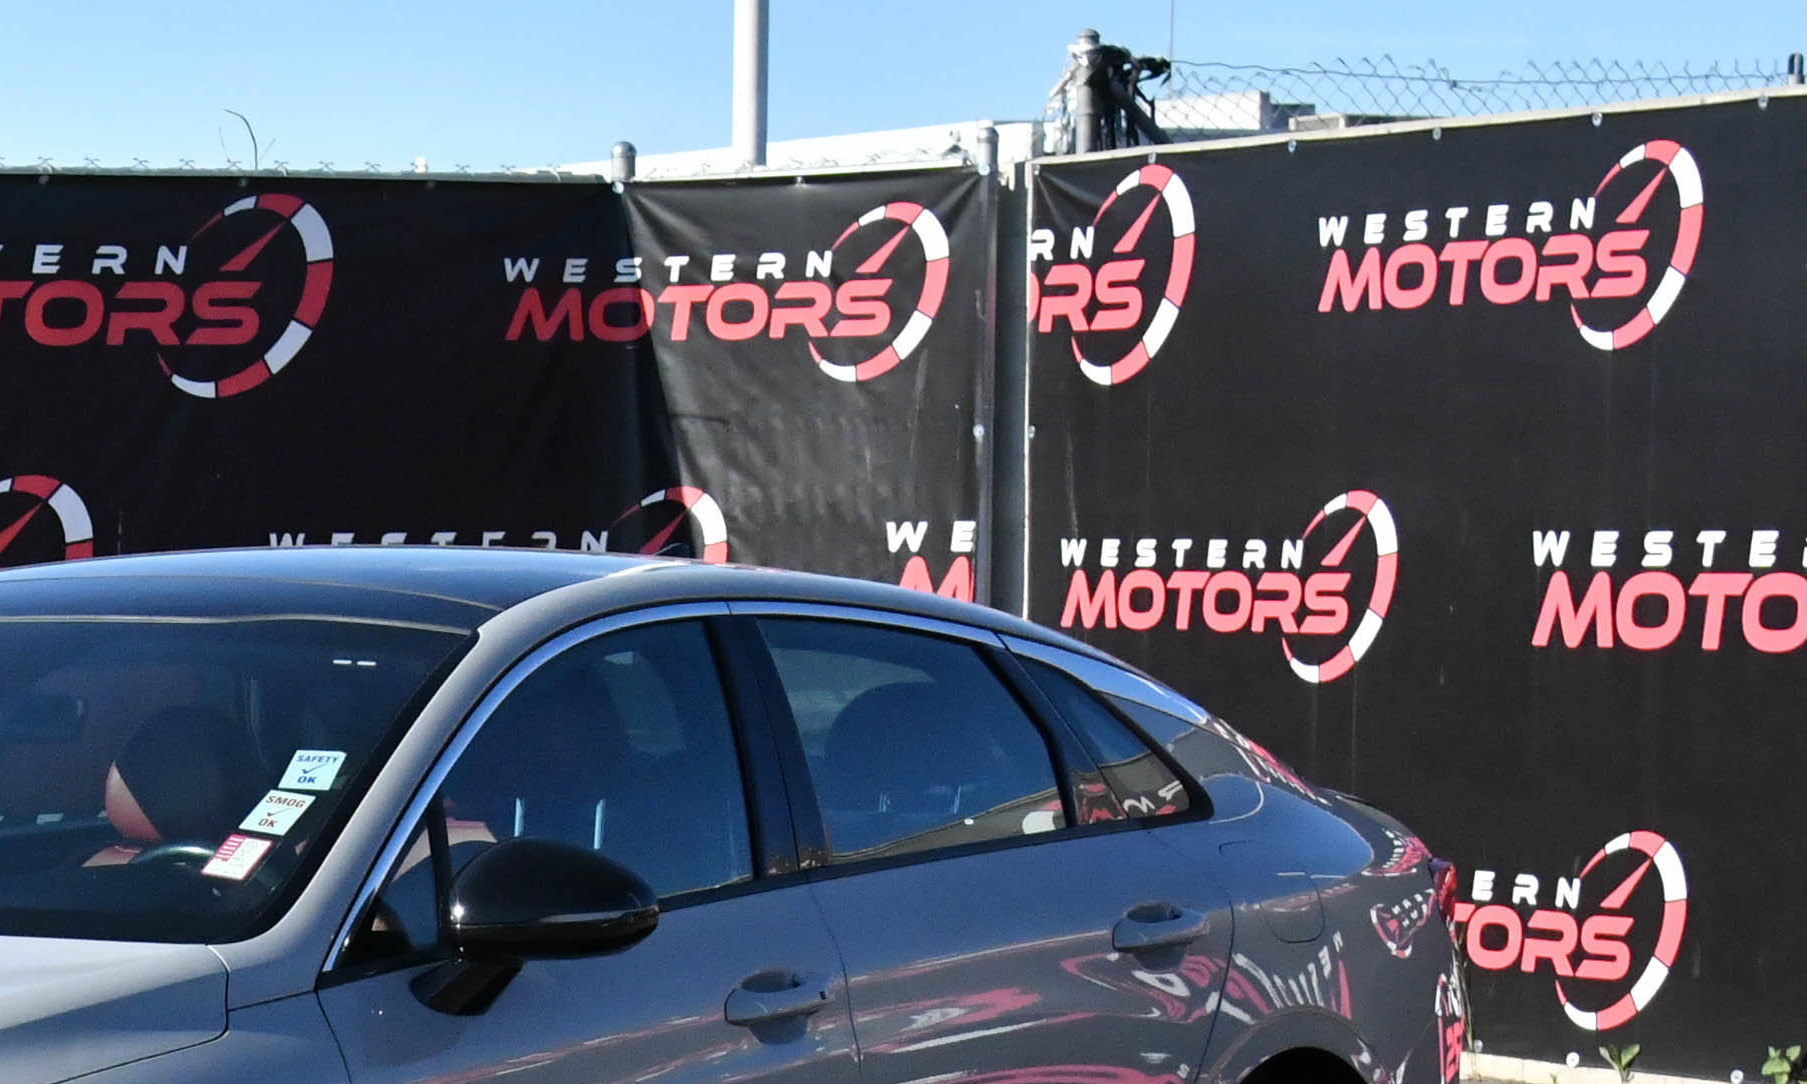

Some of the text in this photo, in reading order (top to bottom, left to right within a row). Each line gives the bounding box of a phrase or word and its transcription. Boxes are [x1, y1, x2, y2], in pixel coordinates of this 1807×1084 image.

[1319, 198, 1596, 247] WESTERN
[504, 250, 833, 283] WESTERN
[1317, 229, 1650, 313] MOTORS
[504, 278, 894, 342] MOTORS
[1060, 538, 1304, 570] WESTERN
[1532, 530, 1807, 568] WESTE
[1060, 569, 1352, 635] MOTORS
[1531, 570, 1807, 654] MOTO
[296, 754, 340, 764] SAFETY
[297, 776, 317, 784] OK
[265, 795, 306, 809] SMOG
[257, 818, 278, 828] OK
